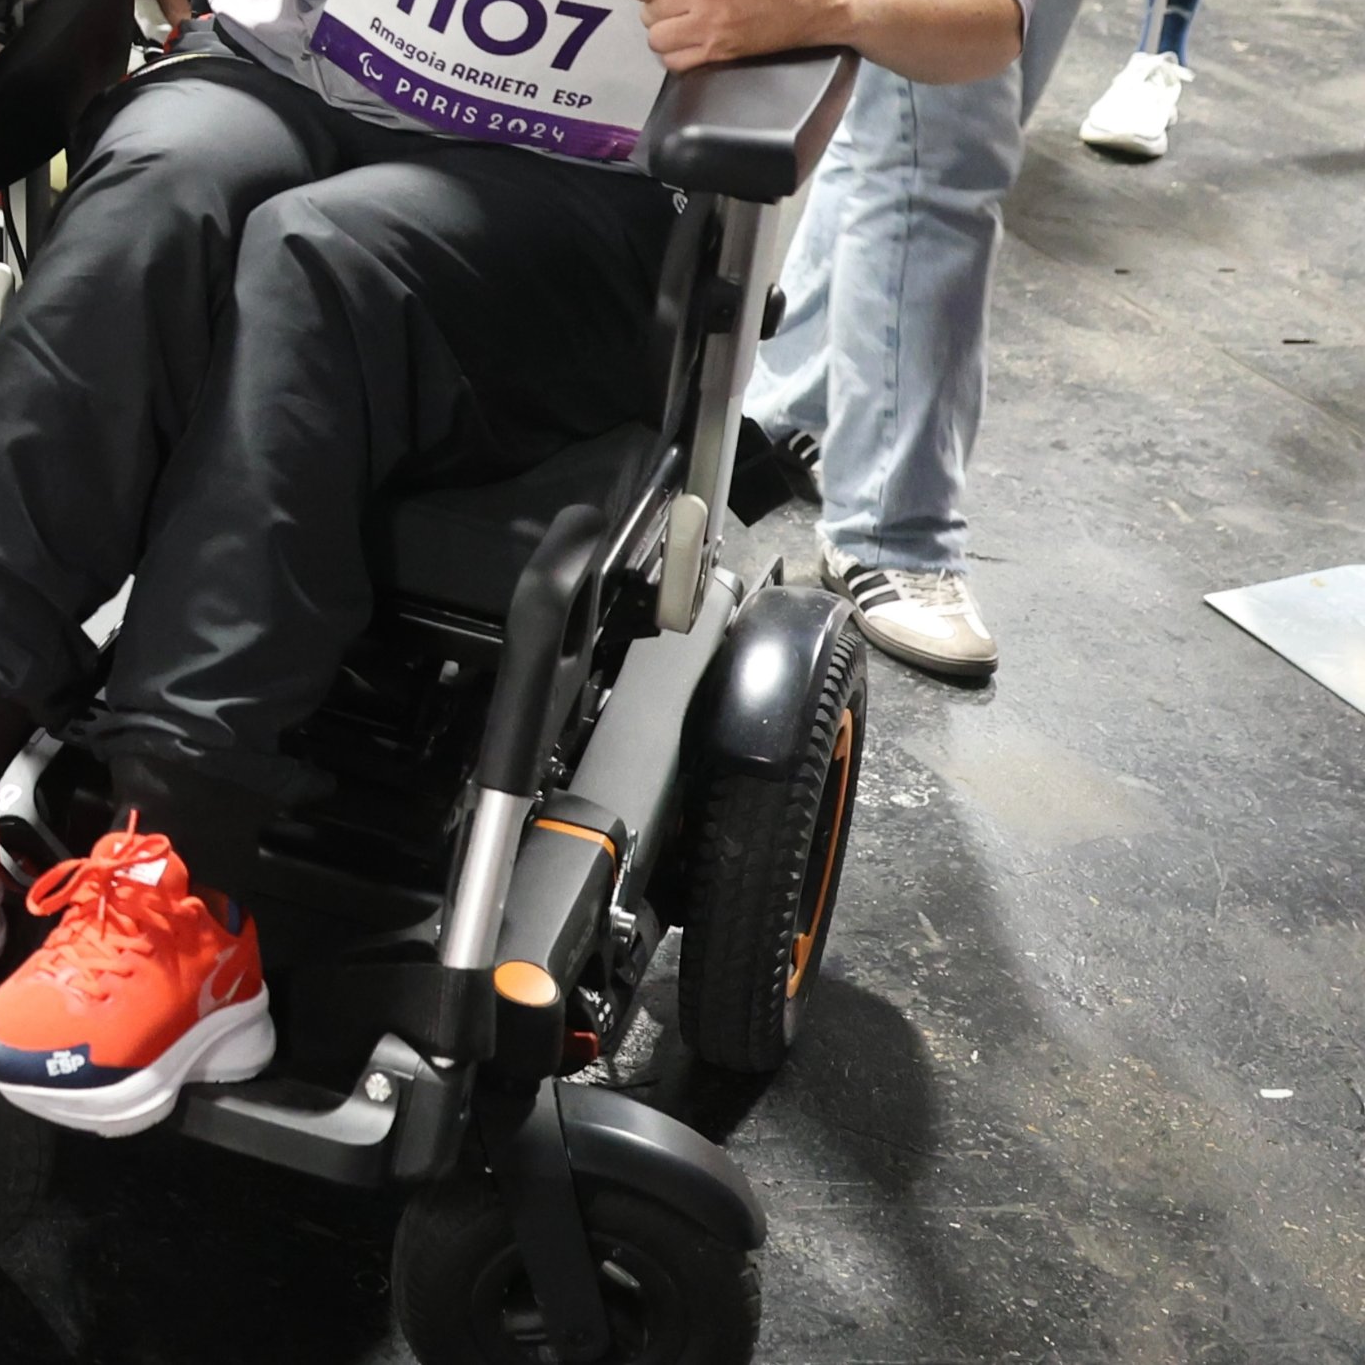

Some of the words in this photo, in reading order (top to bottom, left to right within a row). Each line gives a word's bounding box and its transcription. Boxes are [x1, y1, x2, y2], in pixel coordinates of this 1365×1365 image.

[369, 16, 447, 73] Amagoia
[450, 62, 539, 99] ARRIETA
[552, 89, 593, 109] ESP
[487, 112, 565, 143] 2024
[46, 1054, 85, 1077] ESP
